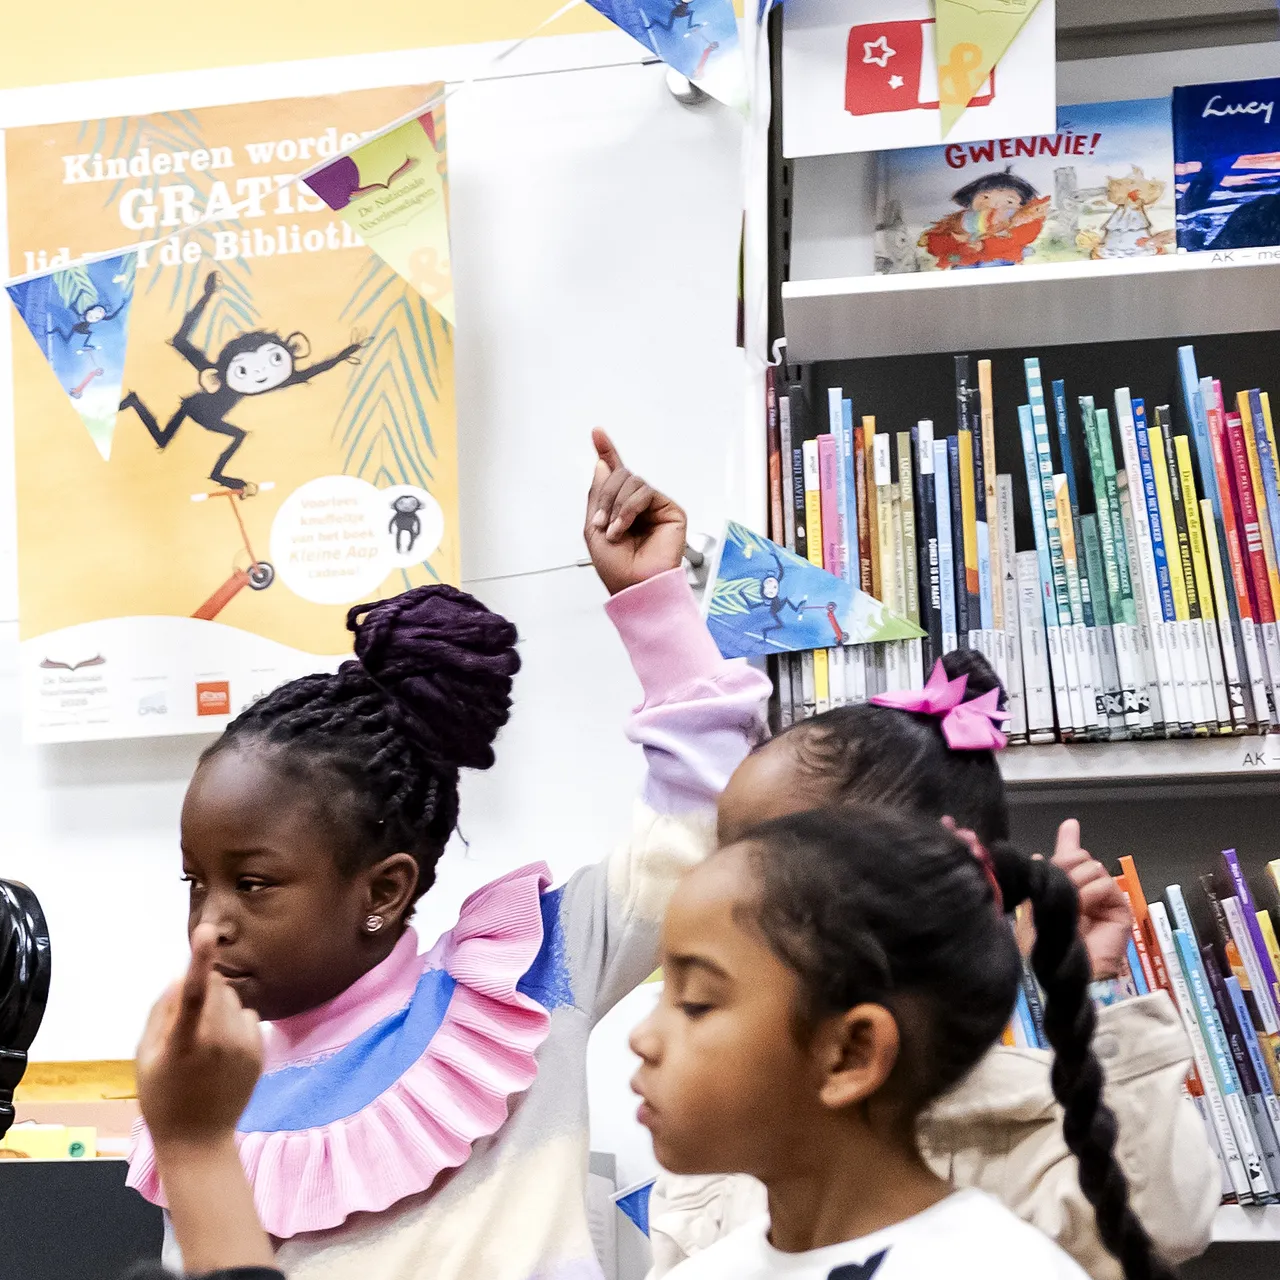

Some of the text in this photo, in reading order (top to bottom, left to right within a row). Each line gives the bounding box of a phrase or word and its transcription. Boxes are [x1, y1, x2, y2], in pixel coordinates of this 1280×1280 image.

[1202, 95, 1274, 124] Lucy
[945, 132, 1102, 169] GWENNIE!
[61, 147, 235, 184] Kinderen
[119, 173, 327, 230] GRATIS
[160, 237, 203, 265] de
[214, 221, 369, 261] Biblioth
[1211, 251, 1234, 263] AK
[1125, 425, 1133, 435] De
[900, 457, 912, 501] LUCINDA
[1182, 470, 1191, 483] De
[1187, 507, 1195, 517] en
[1189, 519, 1198, 529] de
[1242, 752, 1266, 766] AK
